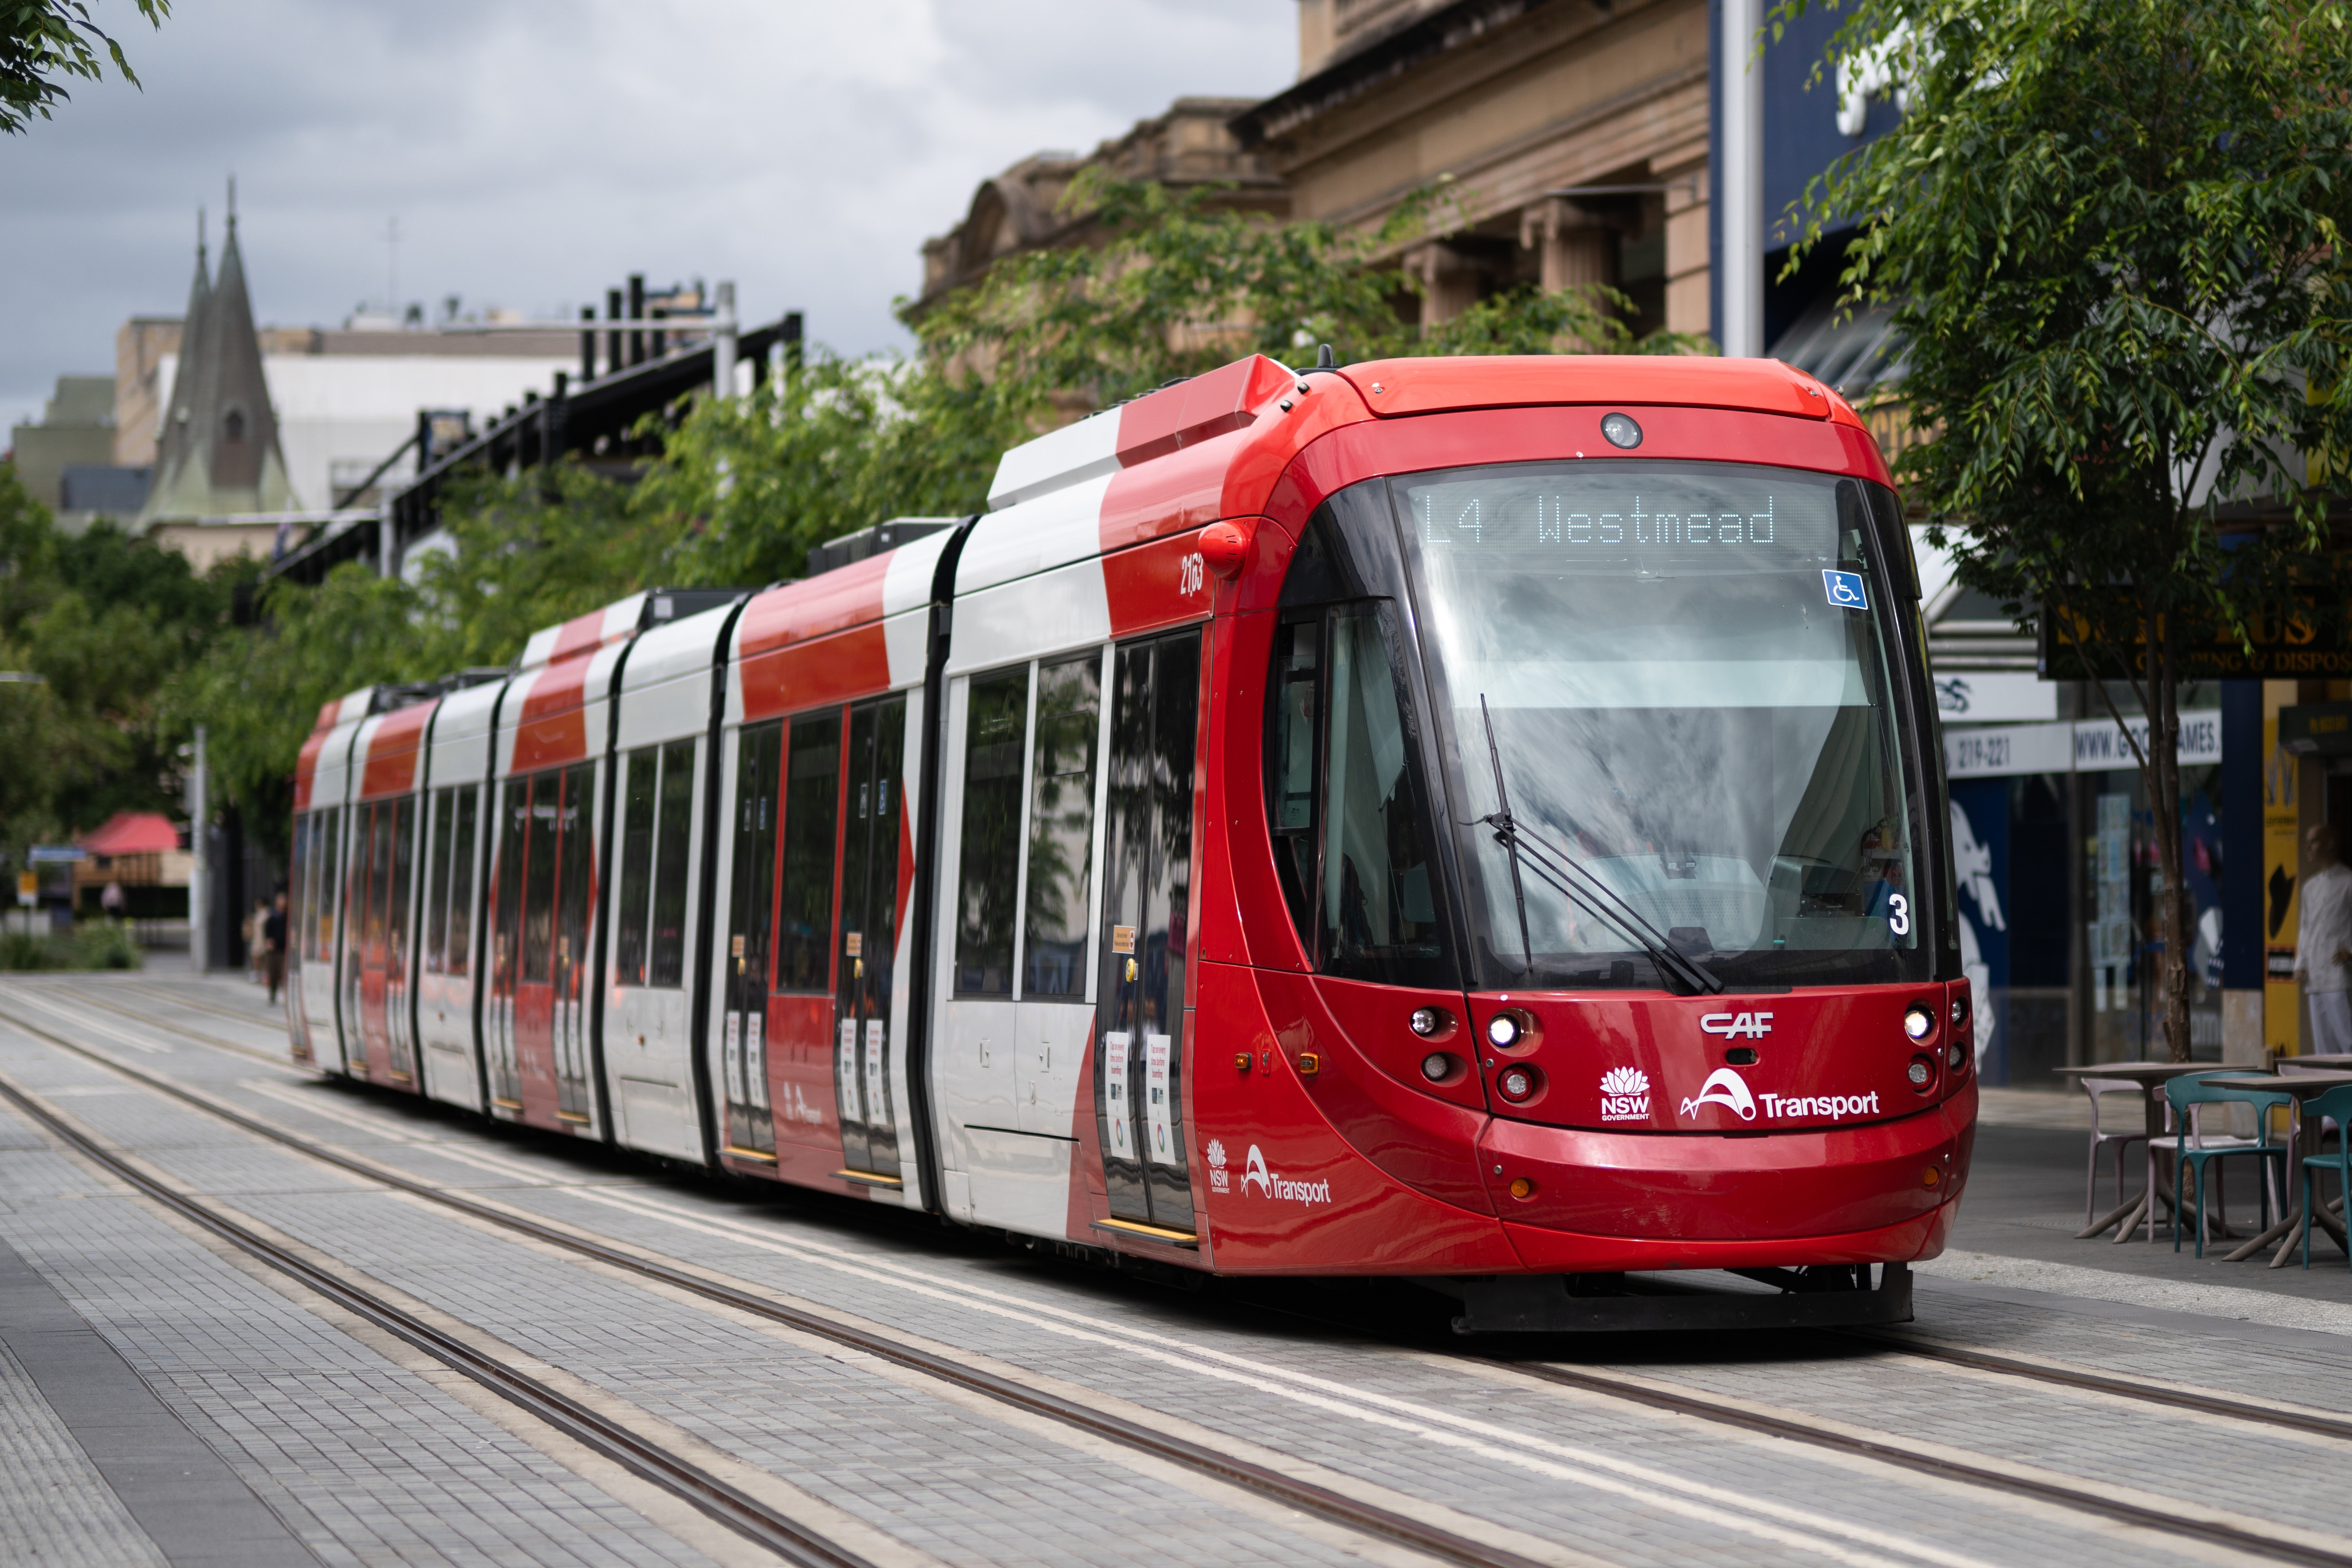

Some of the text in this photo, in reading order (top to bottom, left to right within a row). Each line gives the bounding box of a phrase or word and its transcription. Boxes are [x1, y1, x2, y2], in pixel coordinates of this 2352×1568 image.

[1426, 495, 1774, 544] L4 Westmead
[1180, 552, 1204, 595] 2163
[1889, 893, 1909, 935] 3
[1700, 1012, 1773, 1039] CAF
[1601, 1097, 1649, 1114] NSW
[1759, 1090, 1879, 1120] Transport
[1209, 1170, 1228, 1187] NSW
[1270, 1173, 1331, 1207] Transport
